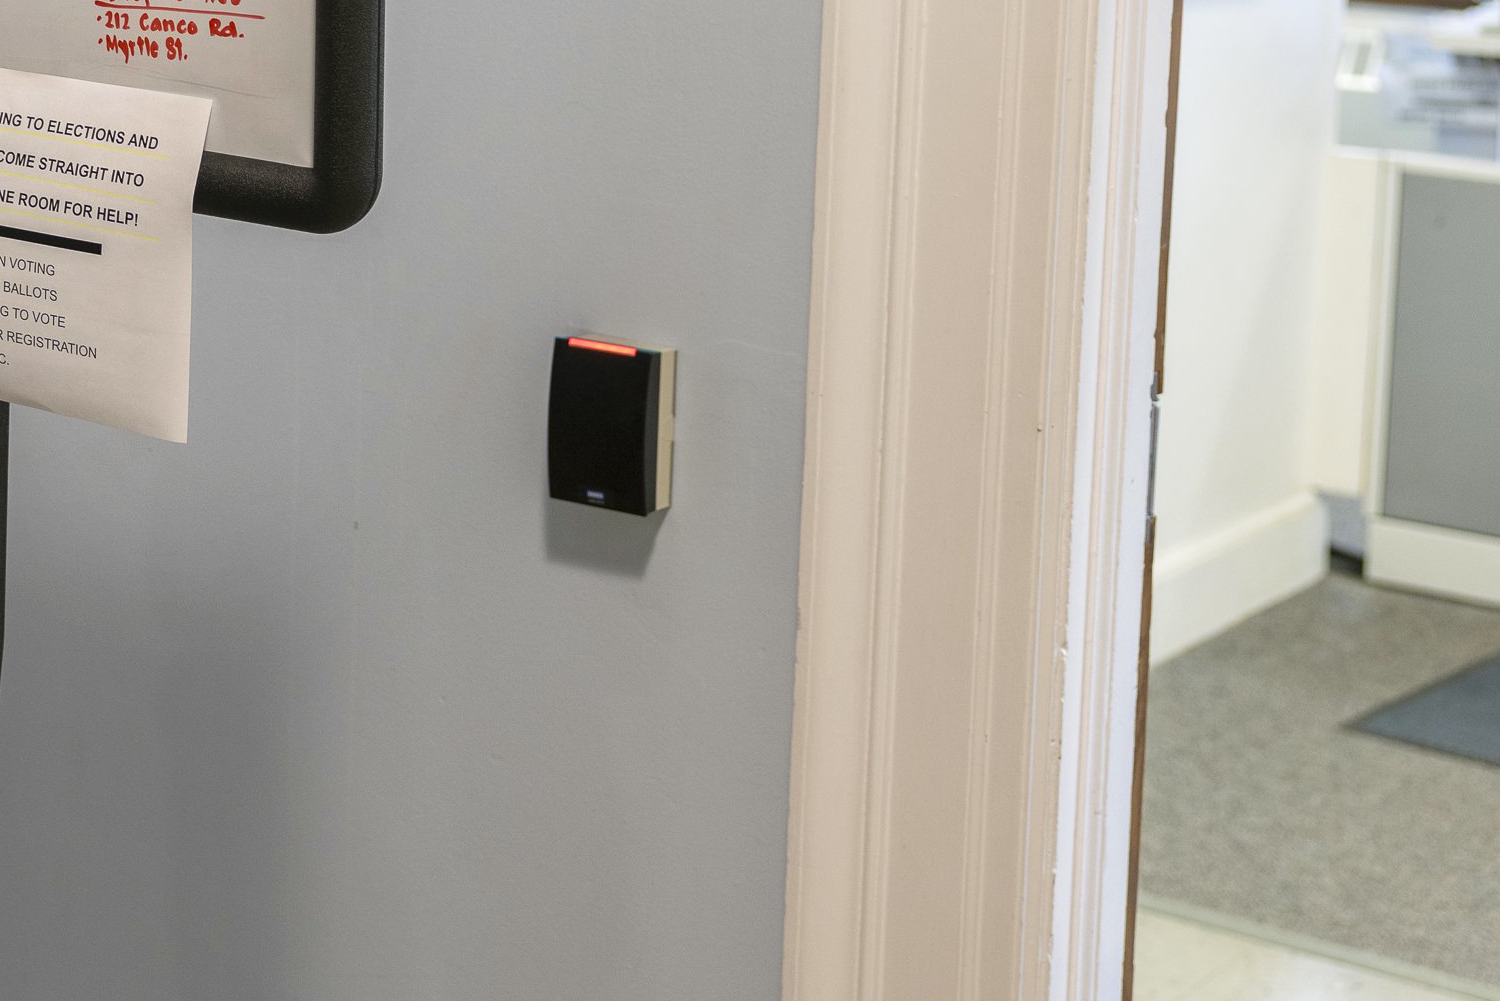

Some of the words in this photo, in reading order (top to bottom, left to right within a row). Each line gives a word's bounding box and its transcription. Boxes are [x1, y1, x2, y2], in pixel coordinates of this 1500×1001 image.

[139, 12, 198, 35] Canco
[209, 18, 244, 38] Rd.
[166, 36, 188, 61] St.
[26, 116, 44, 131] TO
[47, 120, 125, 145] ELECTIONS
[127, 133, 159, 150] AND
[38, 157, 108, 181] STRAIGHT
[110, 169, 144, 187] INTO
[18, 192, 60, 212] ROOM
[63, 201, 93, 219] FOR
[96, 206, 138, 227] HELP!
[9, 256, 56, 277] VOTING
[3, 280, 58, 302] BALLOTS
[13, 307, 29, 321] TO
[32, 310, 66, 329] VOTE
[6, 330, 97, 359] REGISTRATION
